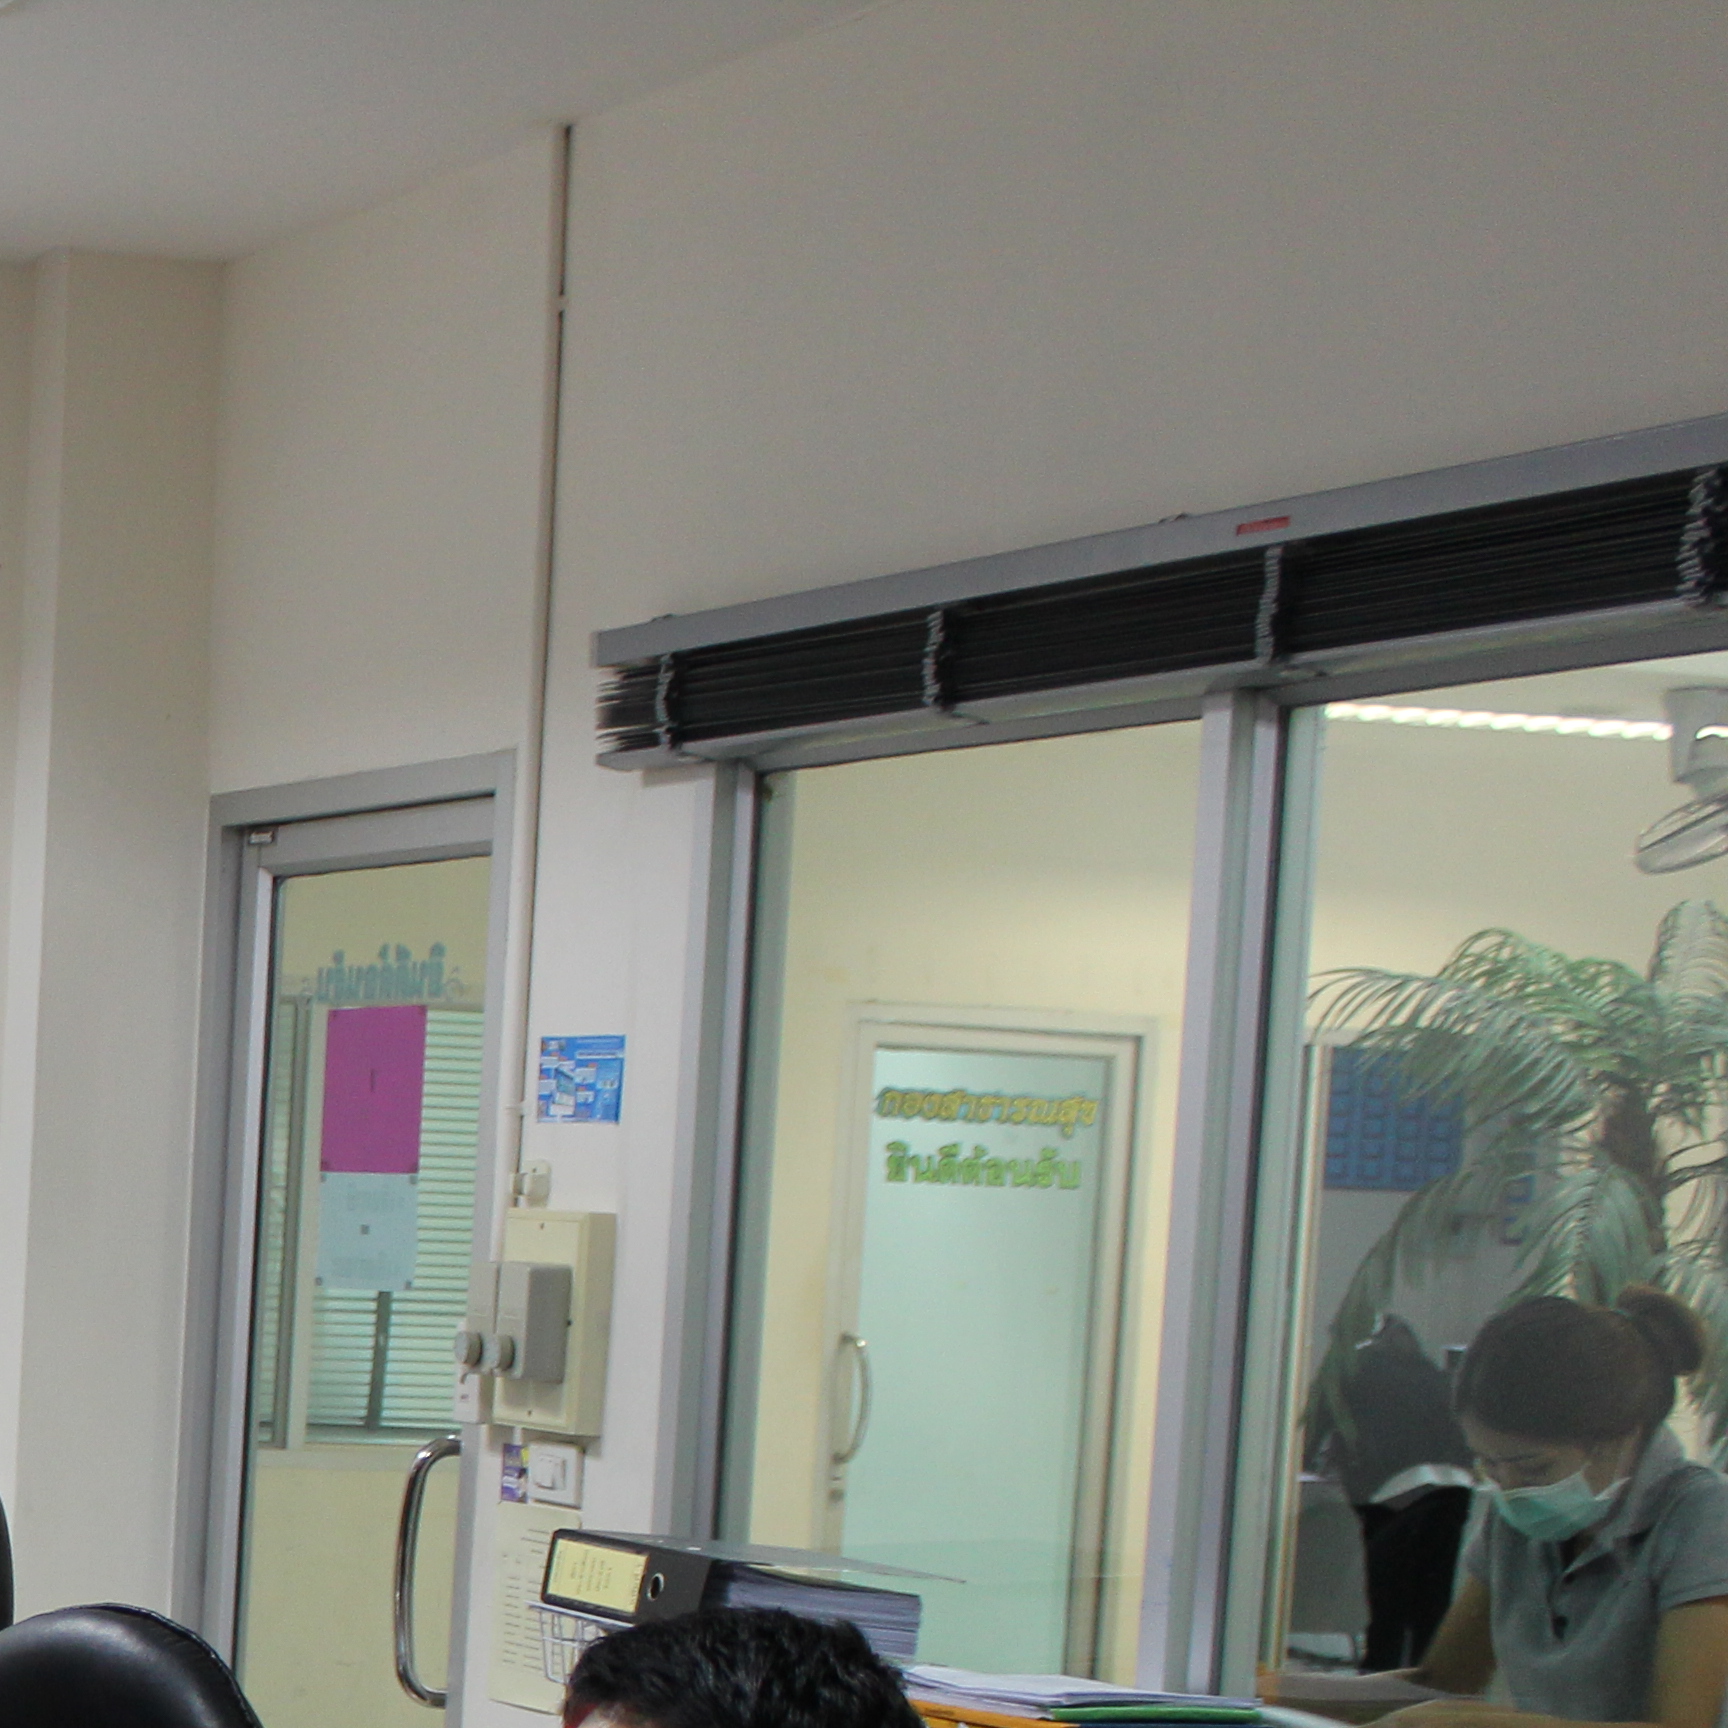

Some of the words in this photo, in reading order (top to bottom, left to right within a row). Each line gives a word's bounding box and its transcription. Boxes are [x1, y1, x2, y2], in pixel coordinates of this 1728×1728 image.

[876, 1087, 1099, 1138] กองสาธารณสุข
[886, 1141, 1082, 1189] ยินดีต้อนรับ
